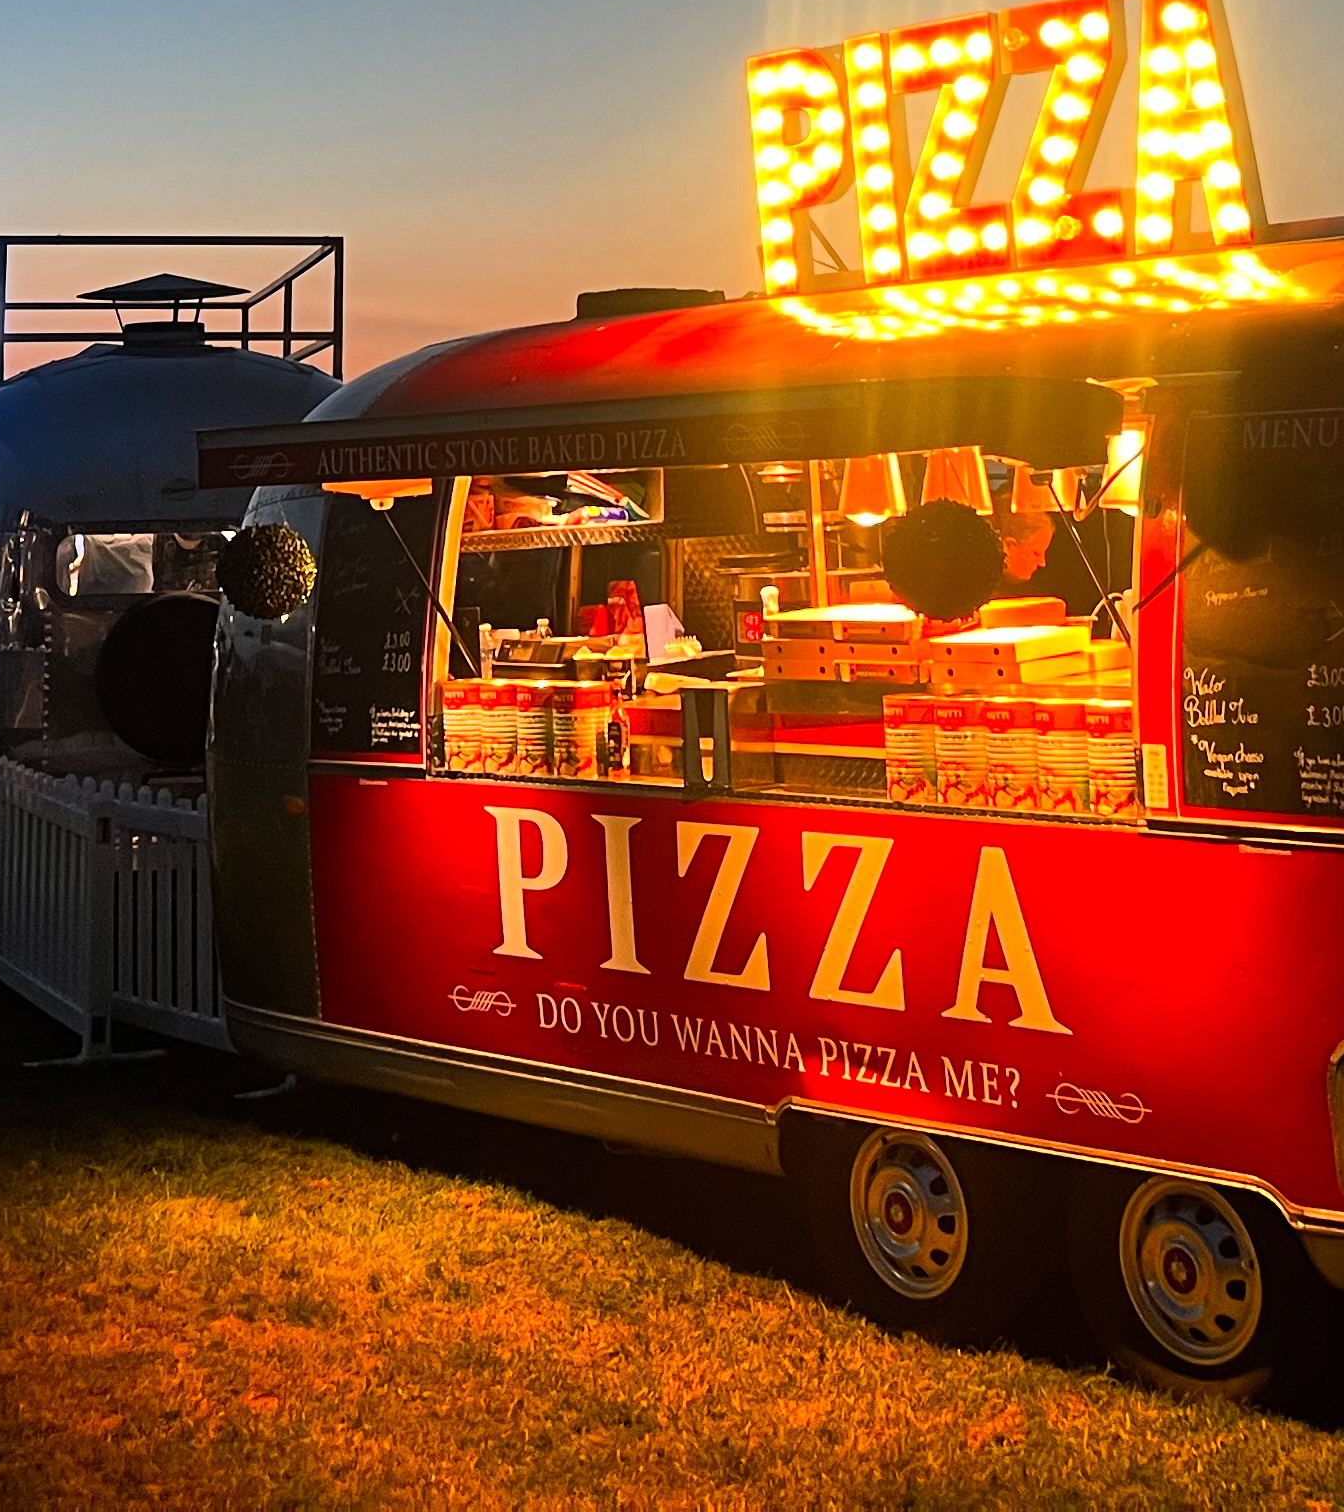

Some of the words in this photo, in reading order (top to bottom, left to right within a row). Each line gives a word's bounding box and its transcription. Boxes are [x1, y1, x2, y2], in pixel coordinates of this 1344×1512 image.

[316, 441, 439, 477] AUTHENTIC
[445, 438, 520, 469] STONE
[528, 433, 606, 465] BAKED
[615, 428, 688, 461] PIZZA
[1242, 416, 1342, 450] MENU
[483, 805, 1074, 1036] PIZZA
[536, 993, 582, 1034] DO
[591, 1001, 660, 1047] YOU
[670, 1013, 806, 1073] WANNA
[818, 1036, 931, 1094] PIZZA
[941, 1056, 1021, 1110] ME?
